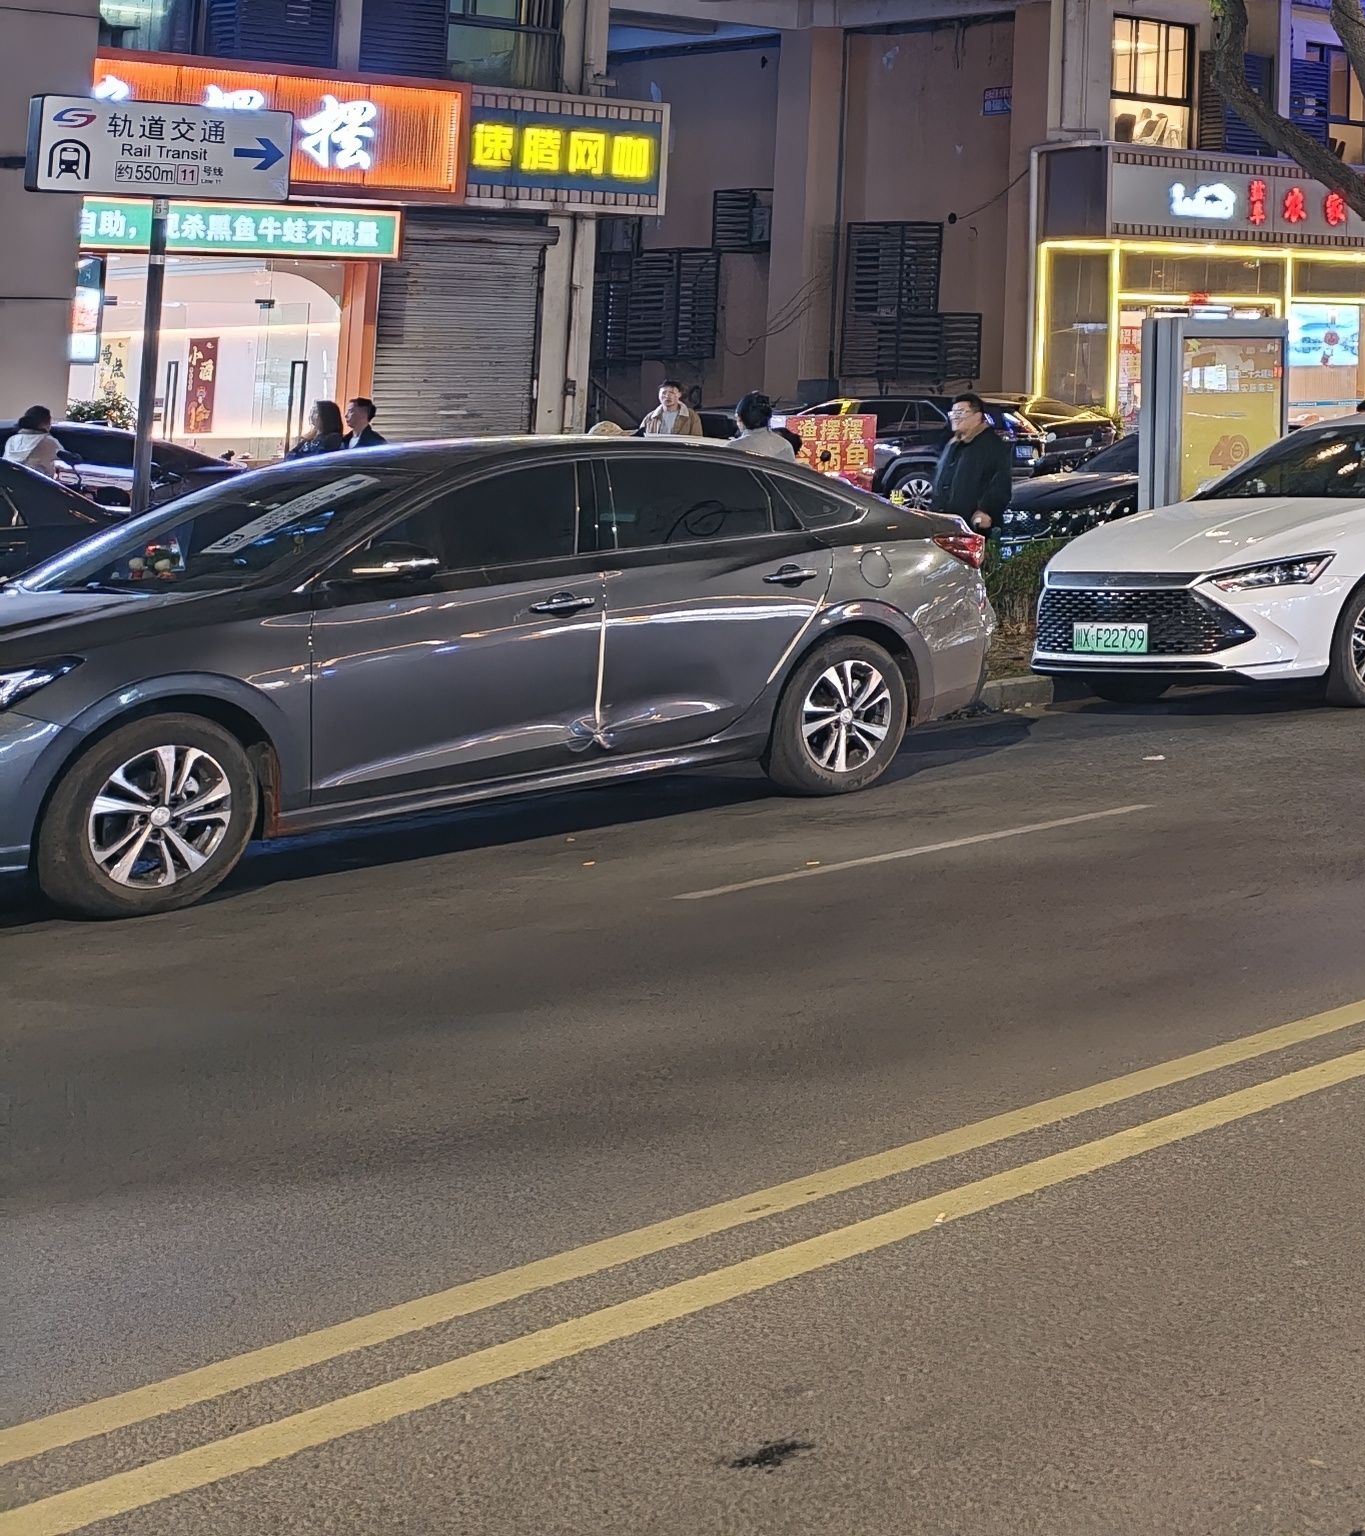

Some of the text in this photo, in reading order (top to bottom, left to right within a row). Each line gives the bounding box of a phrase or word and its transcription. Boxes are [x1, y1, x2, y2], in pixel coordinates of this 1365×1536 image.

[107, 113, 226, 145] 轨道交通
[121, 143, 208, 161] Rail Transit
[472, 123, 651, 178] 速腾网咖
[117, 164, 223, 182] 约550m 11 号线
